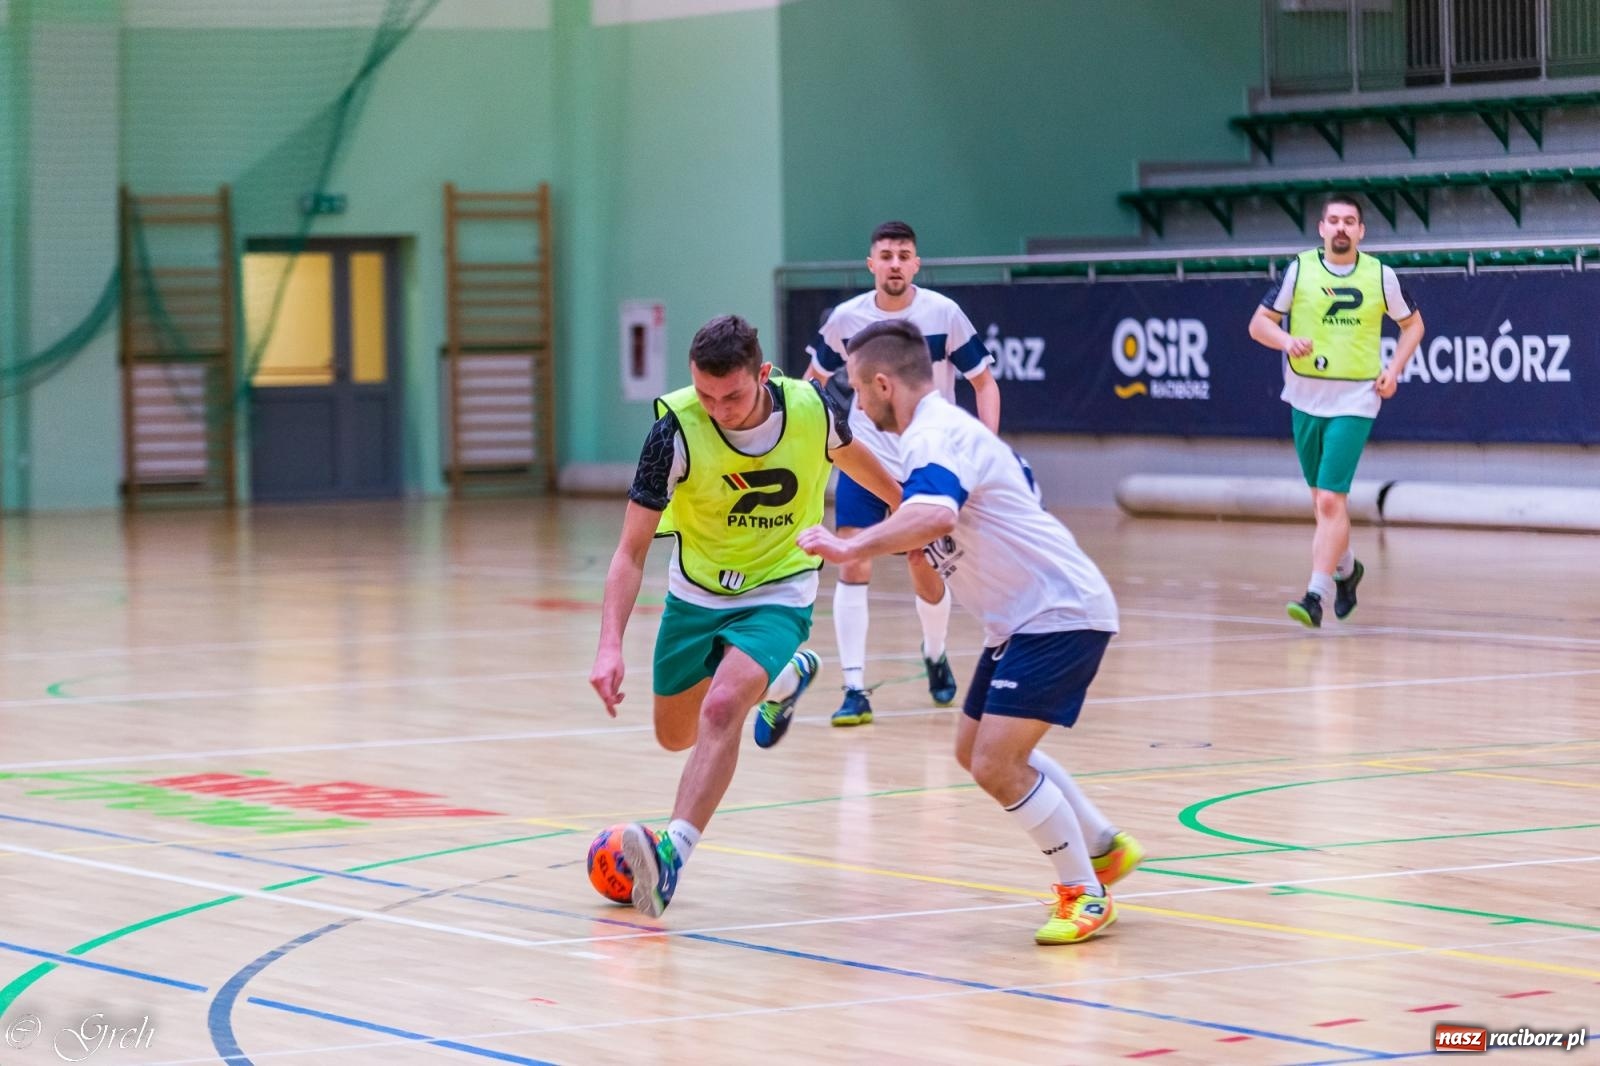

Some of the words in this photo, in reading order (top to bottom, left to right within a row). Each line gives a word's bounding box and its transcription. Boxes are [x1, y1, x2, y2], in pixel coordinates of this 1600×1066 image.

[1321, 317, 1362, 326] PATRICK
[1380, 318, 1572, 383] RACIBÓRZ
[727, 512, 794, 529] PATRICK
